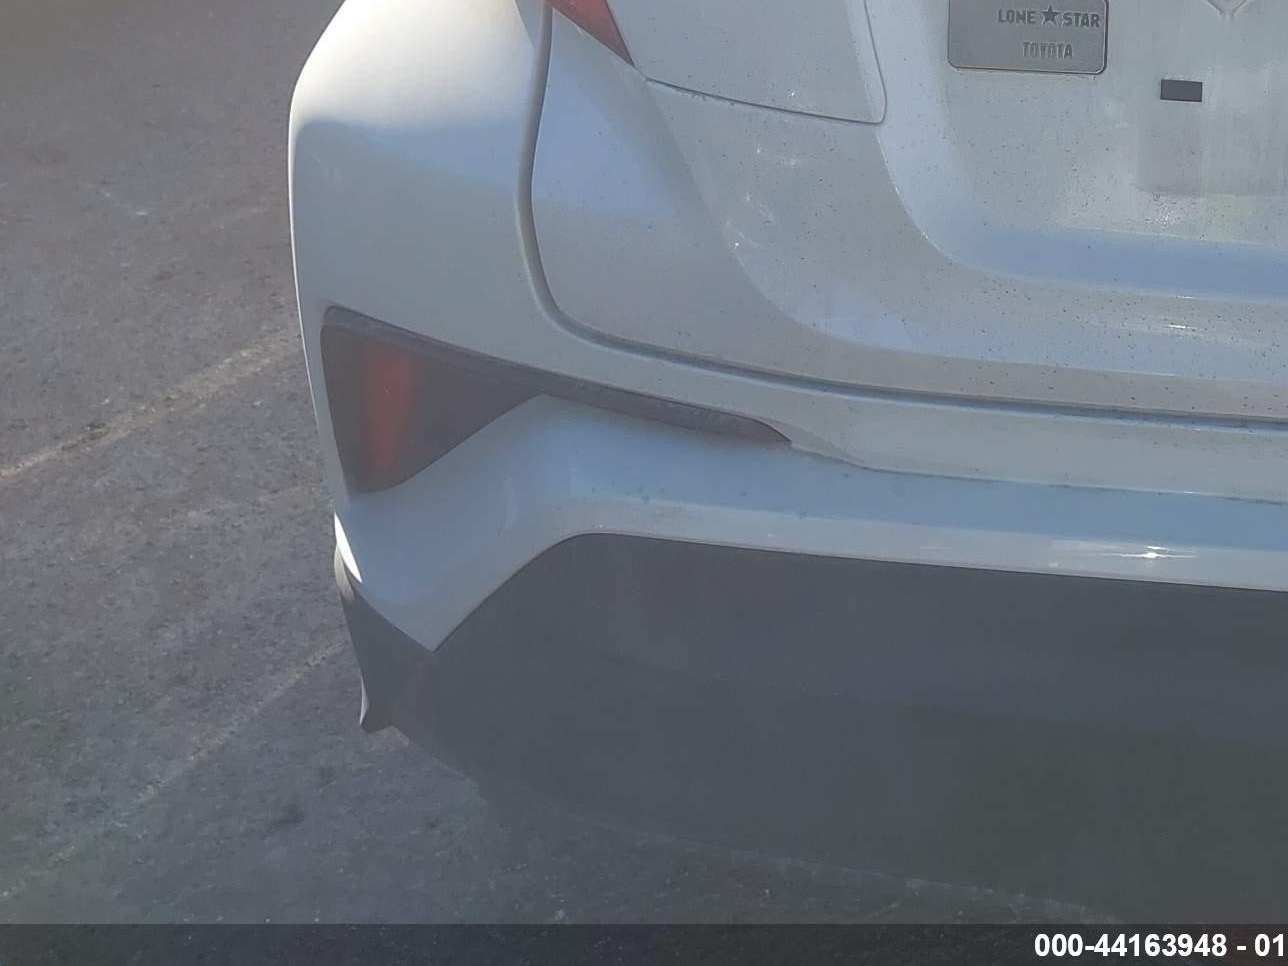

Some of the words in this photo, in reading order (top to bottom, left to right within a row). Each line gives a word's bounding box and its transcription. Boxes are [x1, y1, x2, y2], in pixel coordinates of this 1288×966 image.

[998, 9, 1037, 24] LONE
[1062, 12, 1100, 28] STAR
[1022, 41, 1073, 59] TOYOTA
